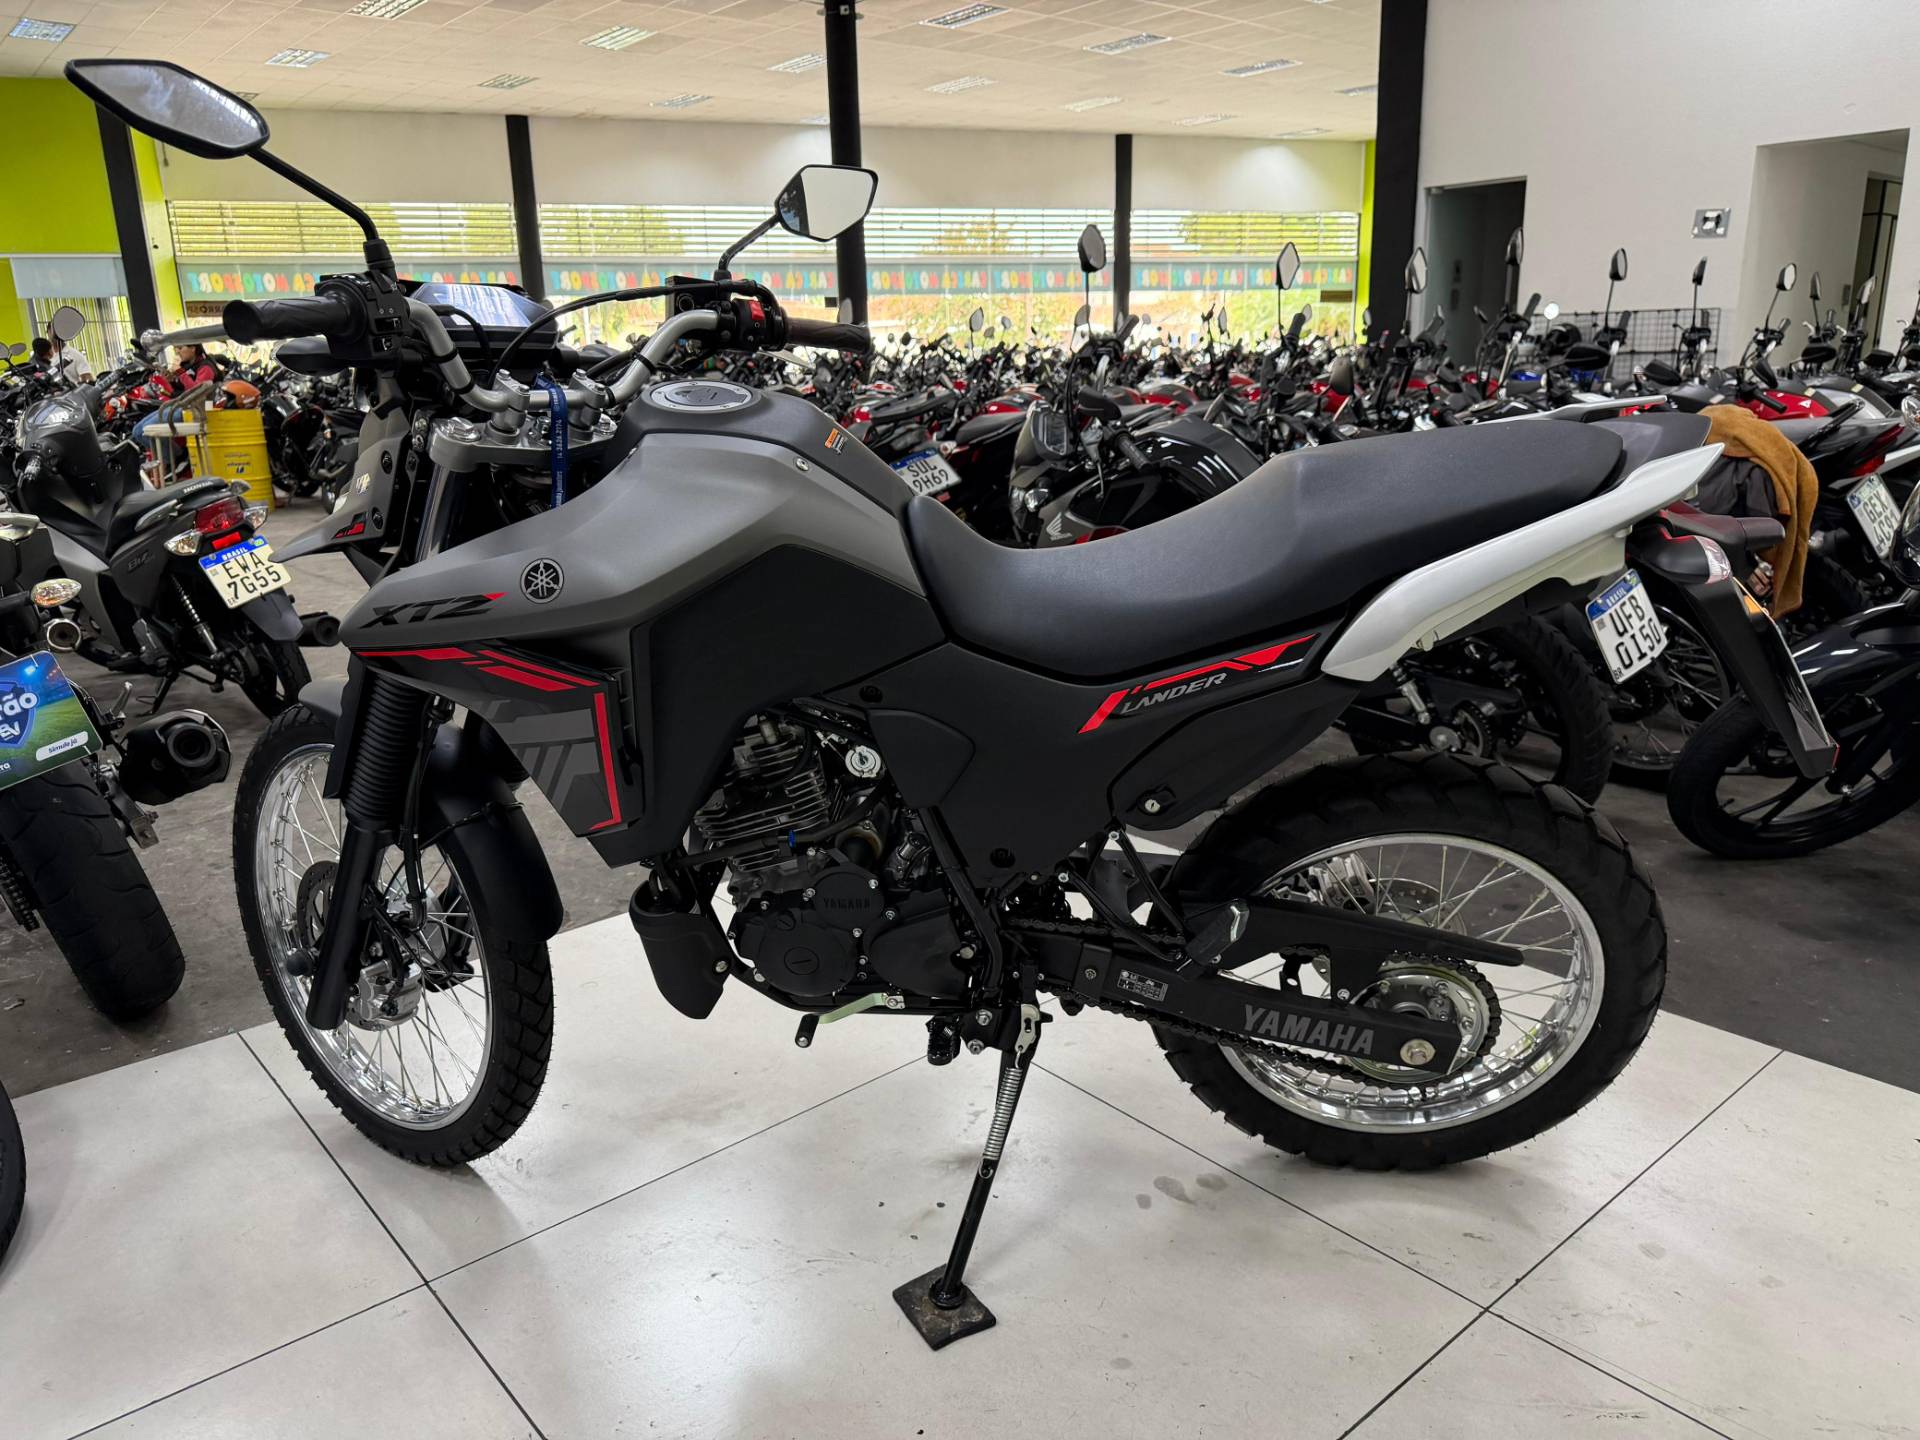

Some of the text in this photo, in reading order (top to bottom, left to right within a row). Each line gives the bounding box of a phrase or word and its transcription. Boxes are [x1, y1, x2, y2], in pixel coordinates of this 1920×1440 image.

[906, 459, 937, 478] SUL
[912, 469, 949, 493] 9H69
[1862, 490, 1889, 524] GEX
[221, 547, 249, 561] BRASIL
[221, 552, 265, 580] EWA
[227, 565, 281, 600] 7G55
[359, 592, 508, 629] XTZ
[1609, 594, 1645, 638] UFB
[1119, 672, 1228, 714] LANDER
[1244, 1004, 1374, 1055] YAMAHA
